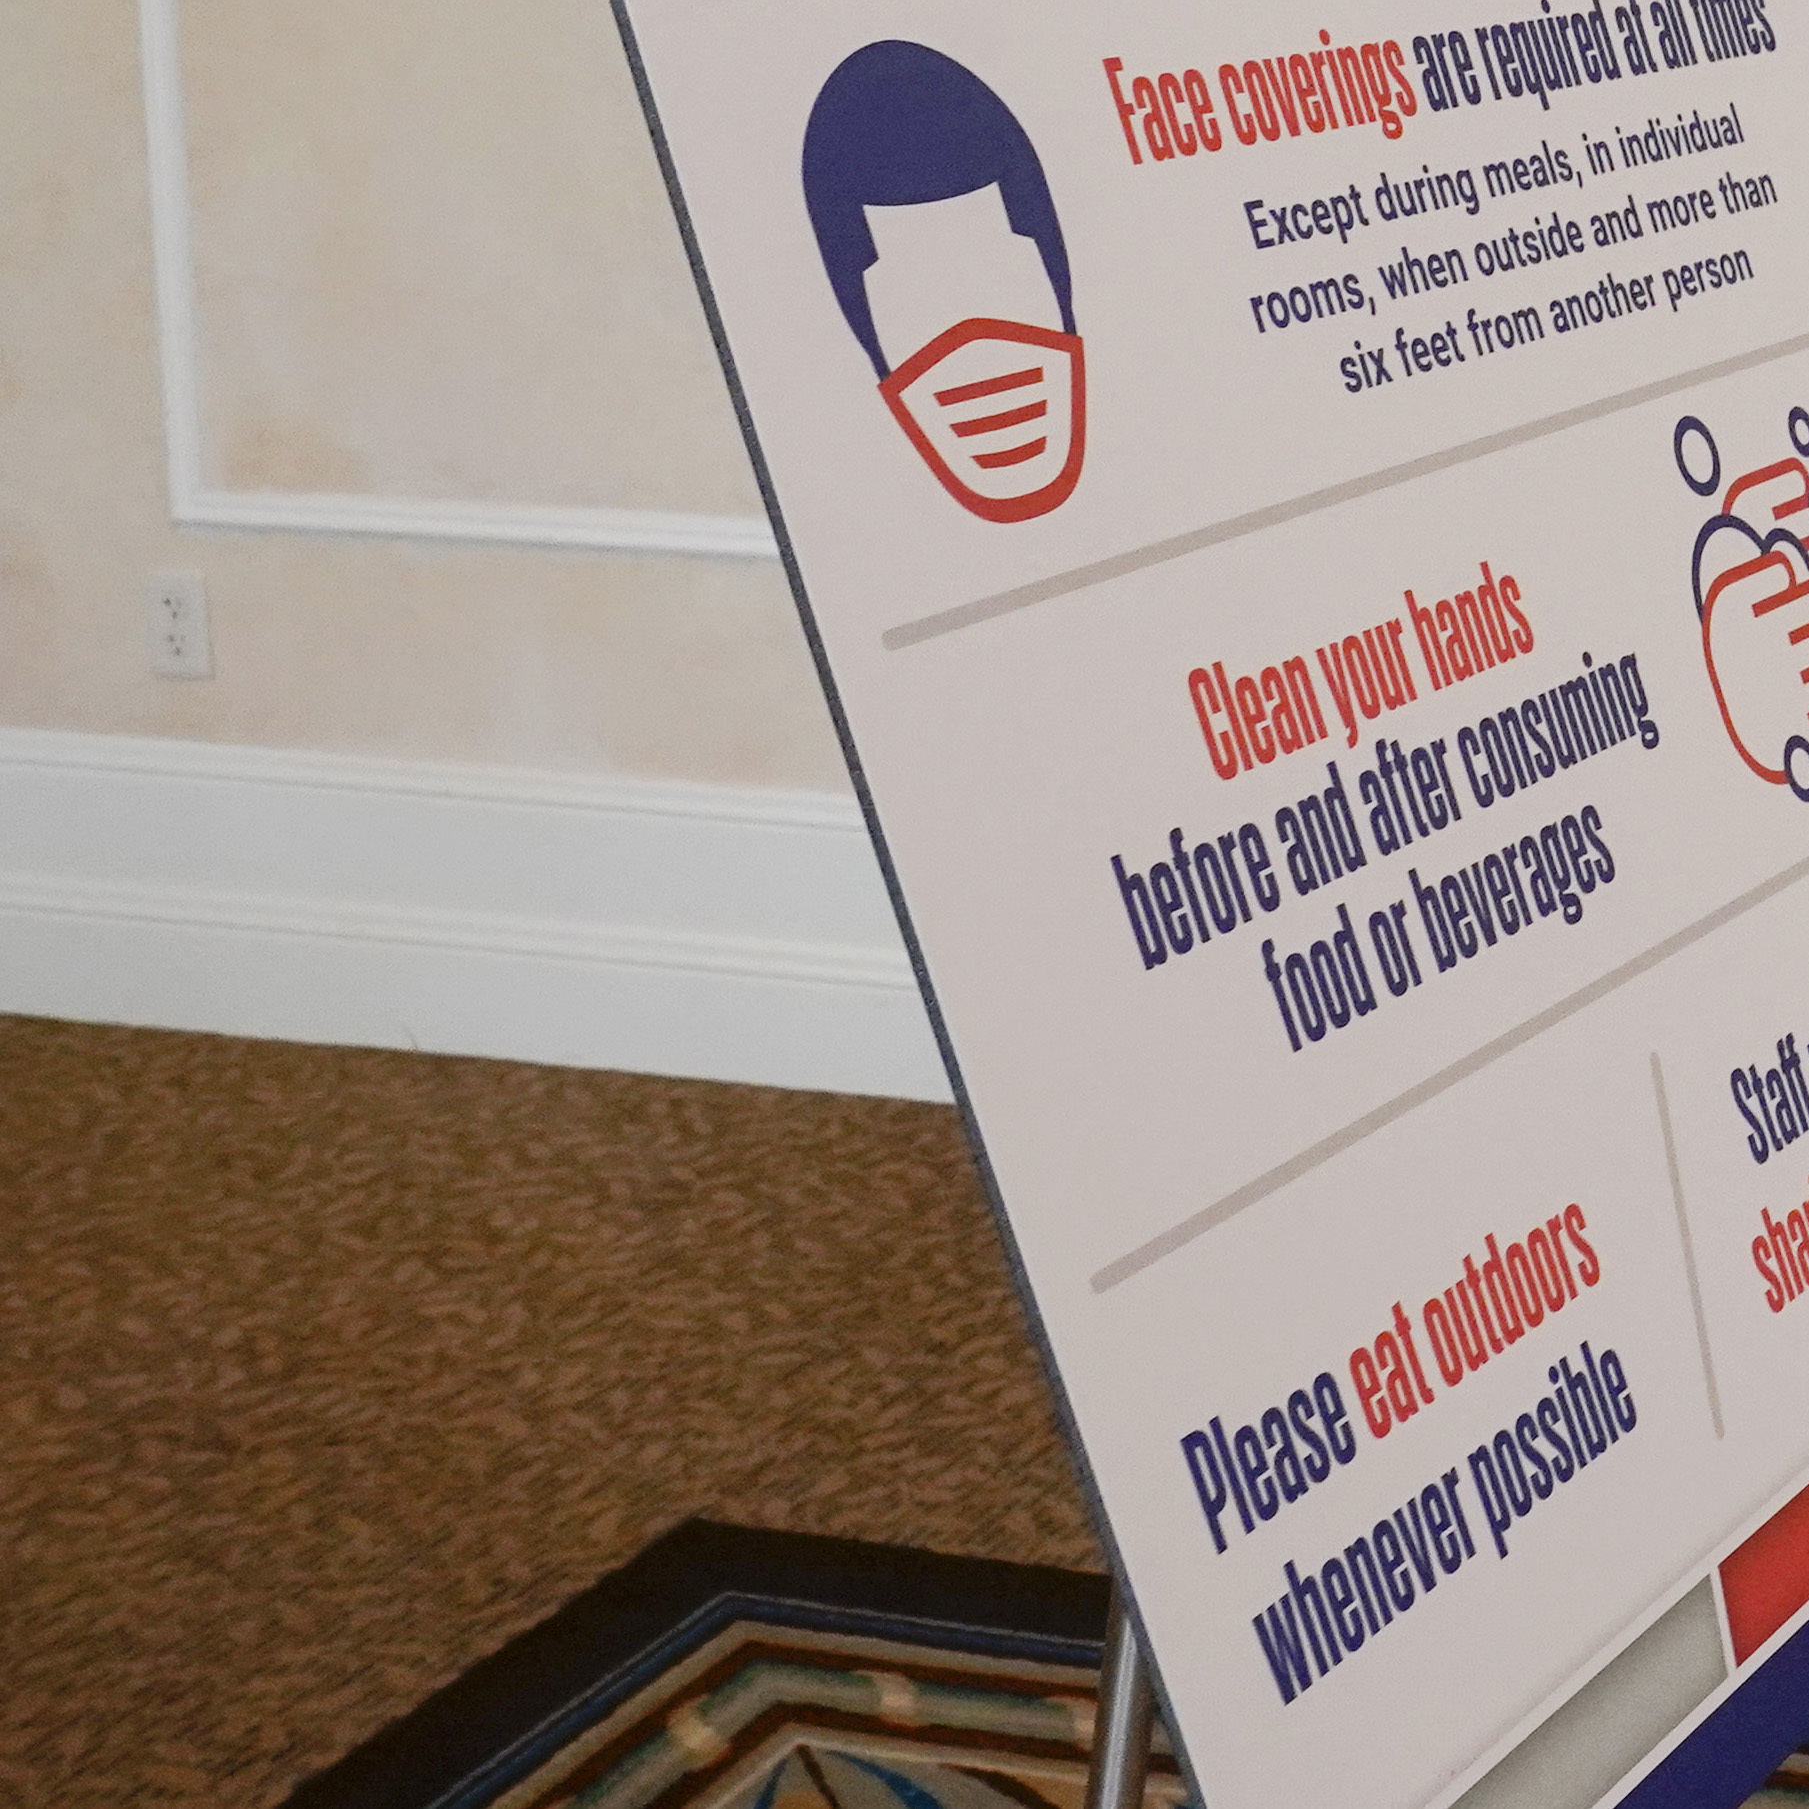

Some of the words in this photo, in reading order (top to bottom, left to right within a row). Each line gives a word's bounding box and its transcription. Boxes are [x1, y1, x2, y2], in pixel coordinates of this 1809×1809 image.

[1102, 56, 1222, 165] Face
[1218, 29, 1417, 139] coverings
[1413, 30, 1481, 112] are
[1243, 184, 1369, 249] Except
[1375, 164, 1480, 224] during
[1483, 140, 1583, 198] meals,
[1582, 133, 1615, 175] in
[1615, 103, 1745, 168] individual
[1250, 272, 1376, 333] rooms,
[1378, 246, 1468, 304] when
[1475, 216, 1585, 278] outside
[1590, 196, 1643, 249] and
[1648, 186, 1716, 234] more
[1718, 171, 1779, 215] than
[1340, 339, 1393, 393] six
[1394, 312, 1465, 376] feet
[1468, 300, 1545, 357] from
[1550, 272, 1658, 333] another
[1663, 249, 1754, 311] person
[1188, 661, 1328, 780] Clean
[1315, 618, 1418, 748] your
[1404, 561, 1535, 691] hands
[1110, 828, 1281, 971] before
[1275, 761, 1367, 896] and
[1359, 738, 1463, 856] after
[1457, 651, 1660, 808] consuming
[1261, 903, 1378, 1052] food
[1368, 899, 1423, 997] or
[1408, 804, 1615, 973] beverages
[1181, 1371, 1357, 1555] Please
[1349, 1300, 1436, 1439] eat
[1422, 1202, 1600, 1387] outdoors
[1251, 1467, 1476, 1706] whenever
[1467, 1340, 1637, 1559] possible
